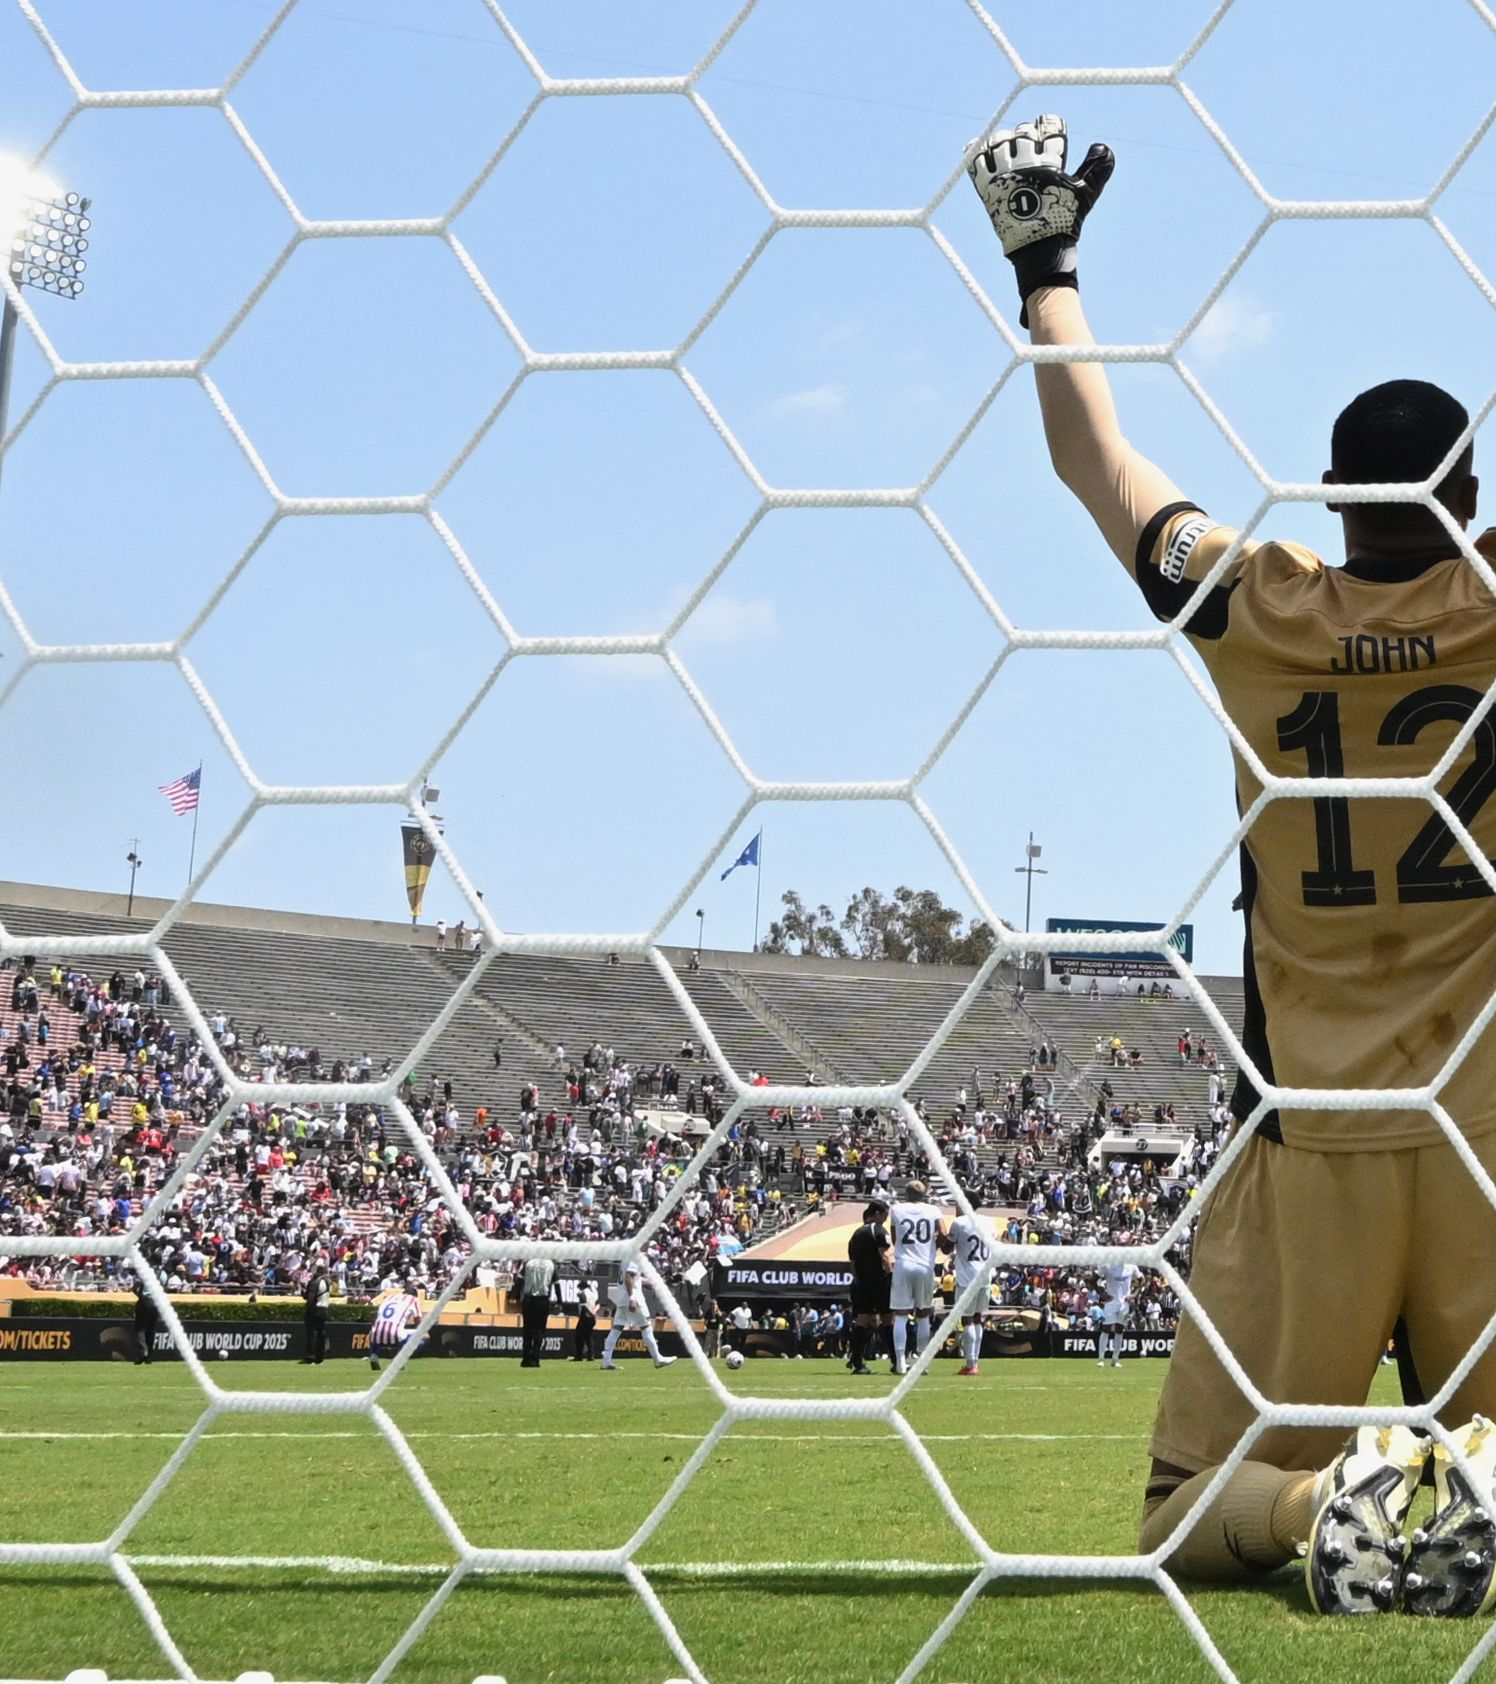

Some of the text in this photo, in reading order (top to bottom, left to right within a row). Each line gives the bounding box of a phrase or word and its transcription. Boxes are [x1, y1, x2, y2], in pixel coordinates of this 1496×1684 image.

[1331, 634, 1436, 675] JOHN
[900, 1218, 931, 1245] 20
[727, 1270, 854, 1286] FIFA CLUB WORLD
[382, 1301, 398, 1319] 6
[205, 1333, 243, 1350] WORLD
[243, 1333, 262, 1350] CUP
[473, 1335, 489, 1350] FIFA
[489, 1335, 507, 1350] CLUB
[507, 1336, 523, 1350] WOR
[1064, 1338, 1097, 1352] FIFA
[1140, 1338, 1176, 1352] WOR
